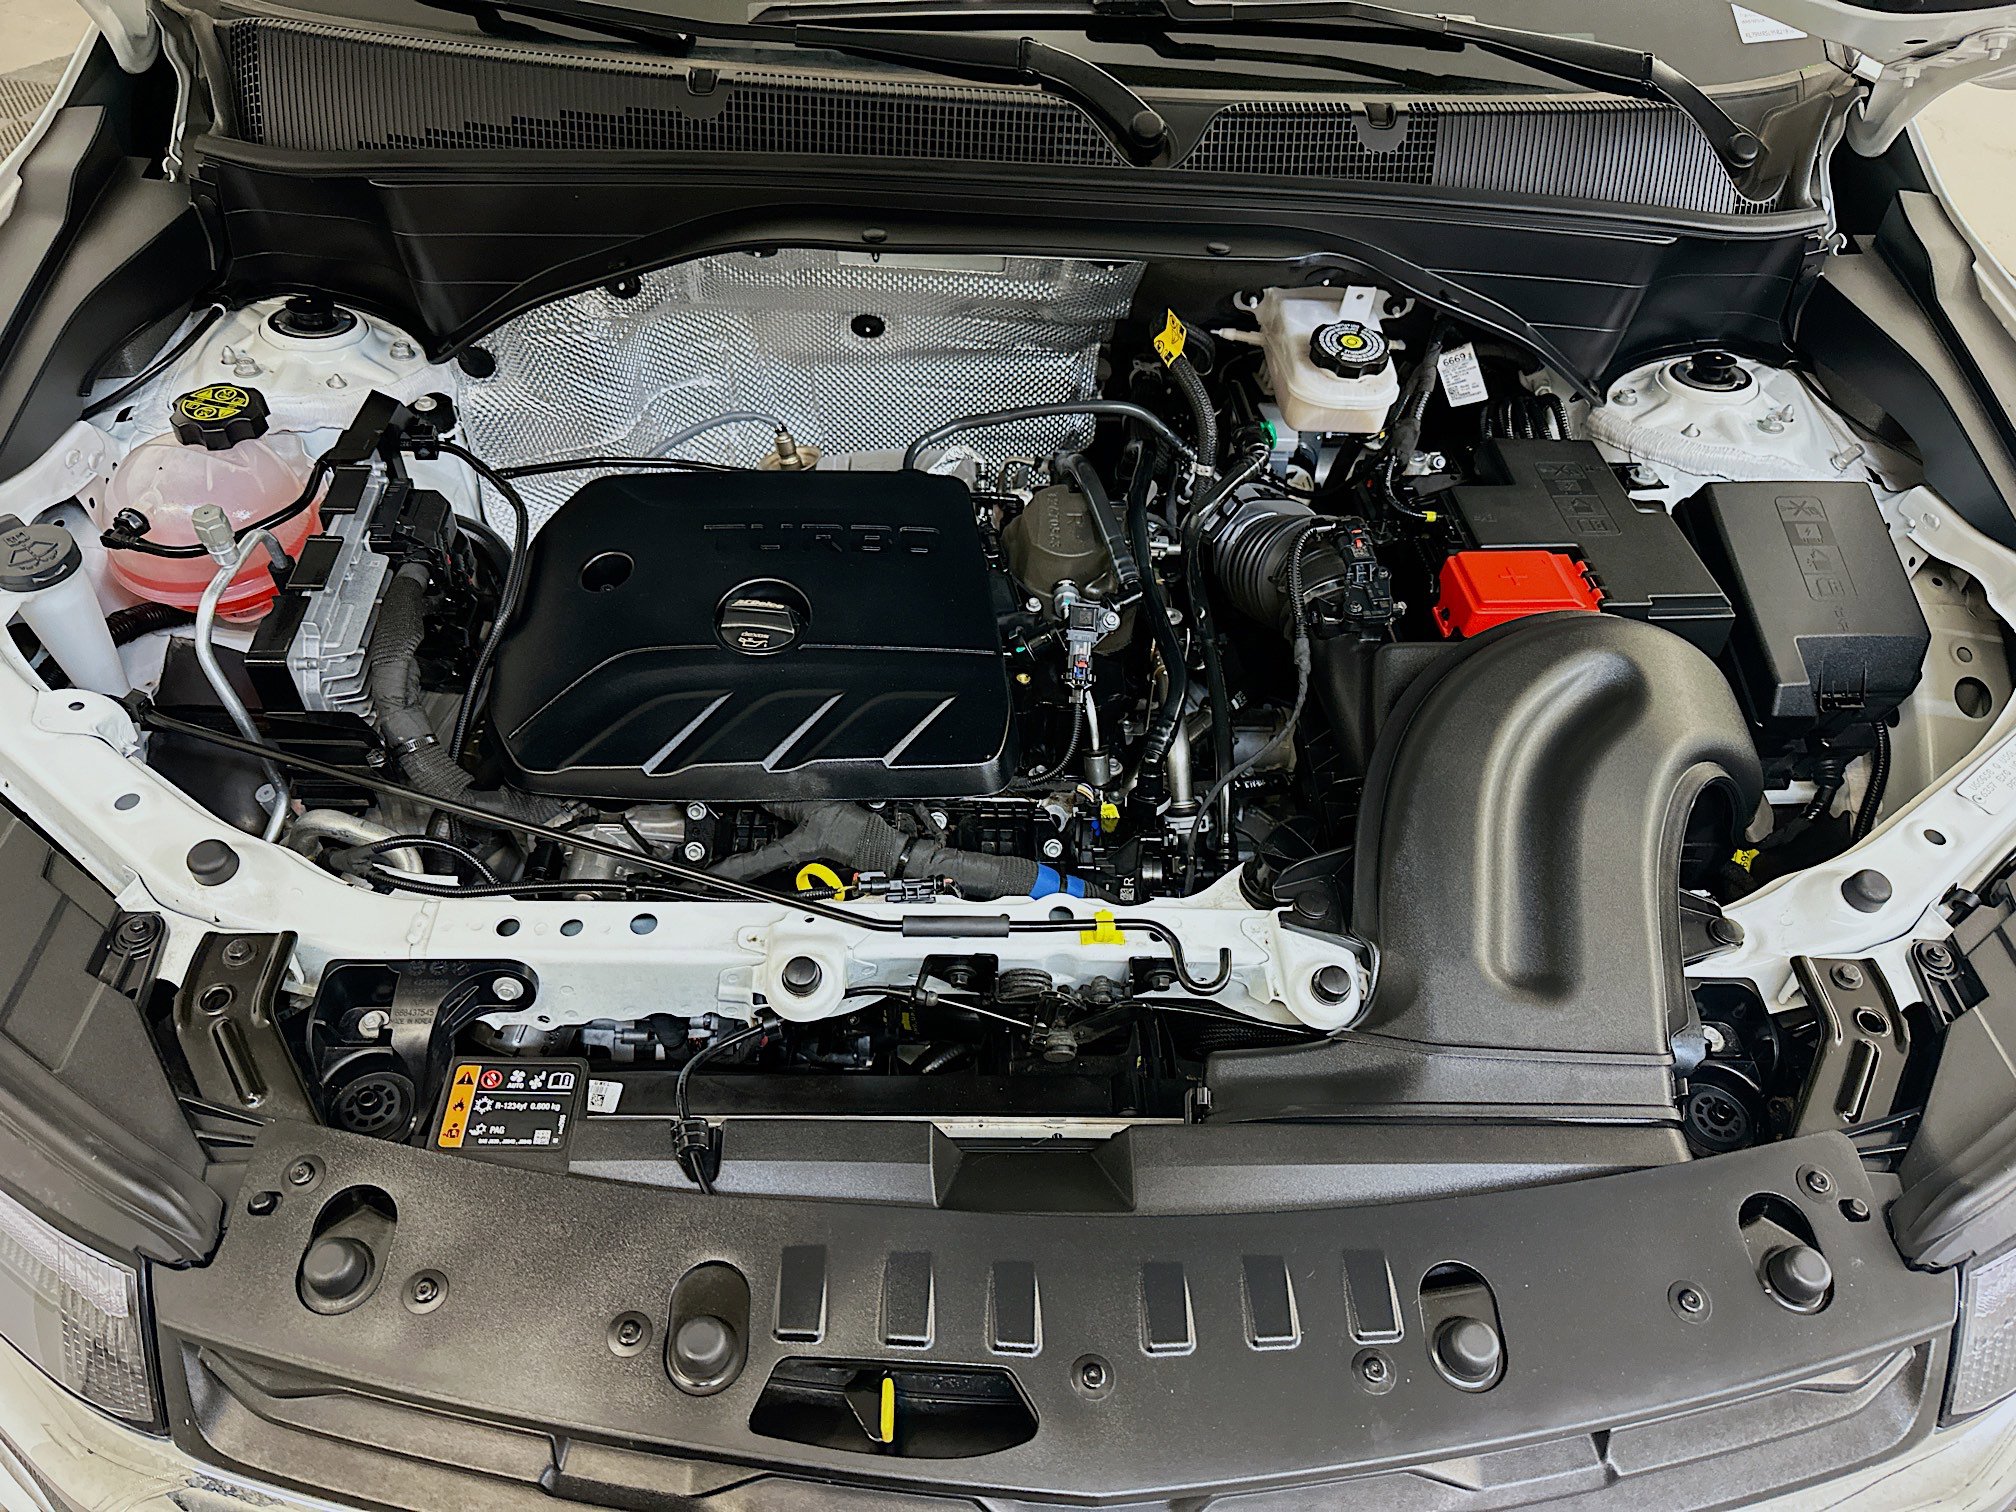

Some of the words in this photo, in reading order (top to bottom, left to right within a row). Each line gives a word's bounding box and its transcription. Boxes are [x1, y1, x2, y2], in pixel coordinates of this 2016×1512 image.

[1443, 352, 1466, 367] 6669
[703, 523, 940, 554] TURBO
[551, 1102, 561, 1112] kg
[489, 1125, 506, 1135] PAG
